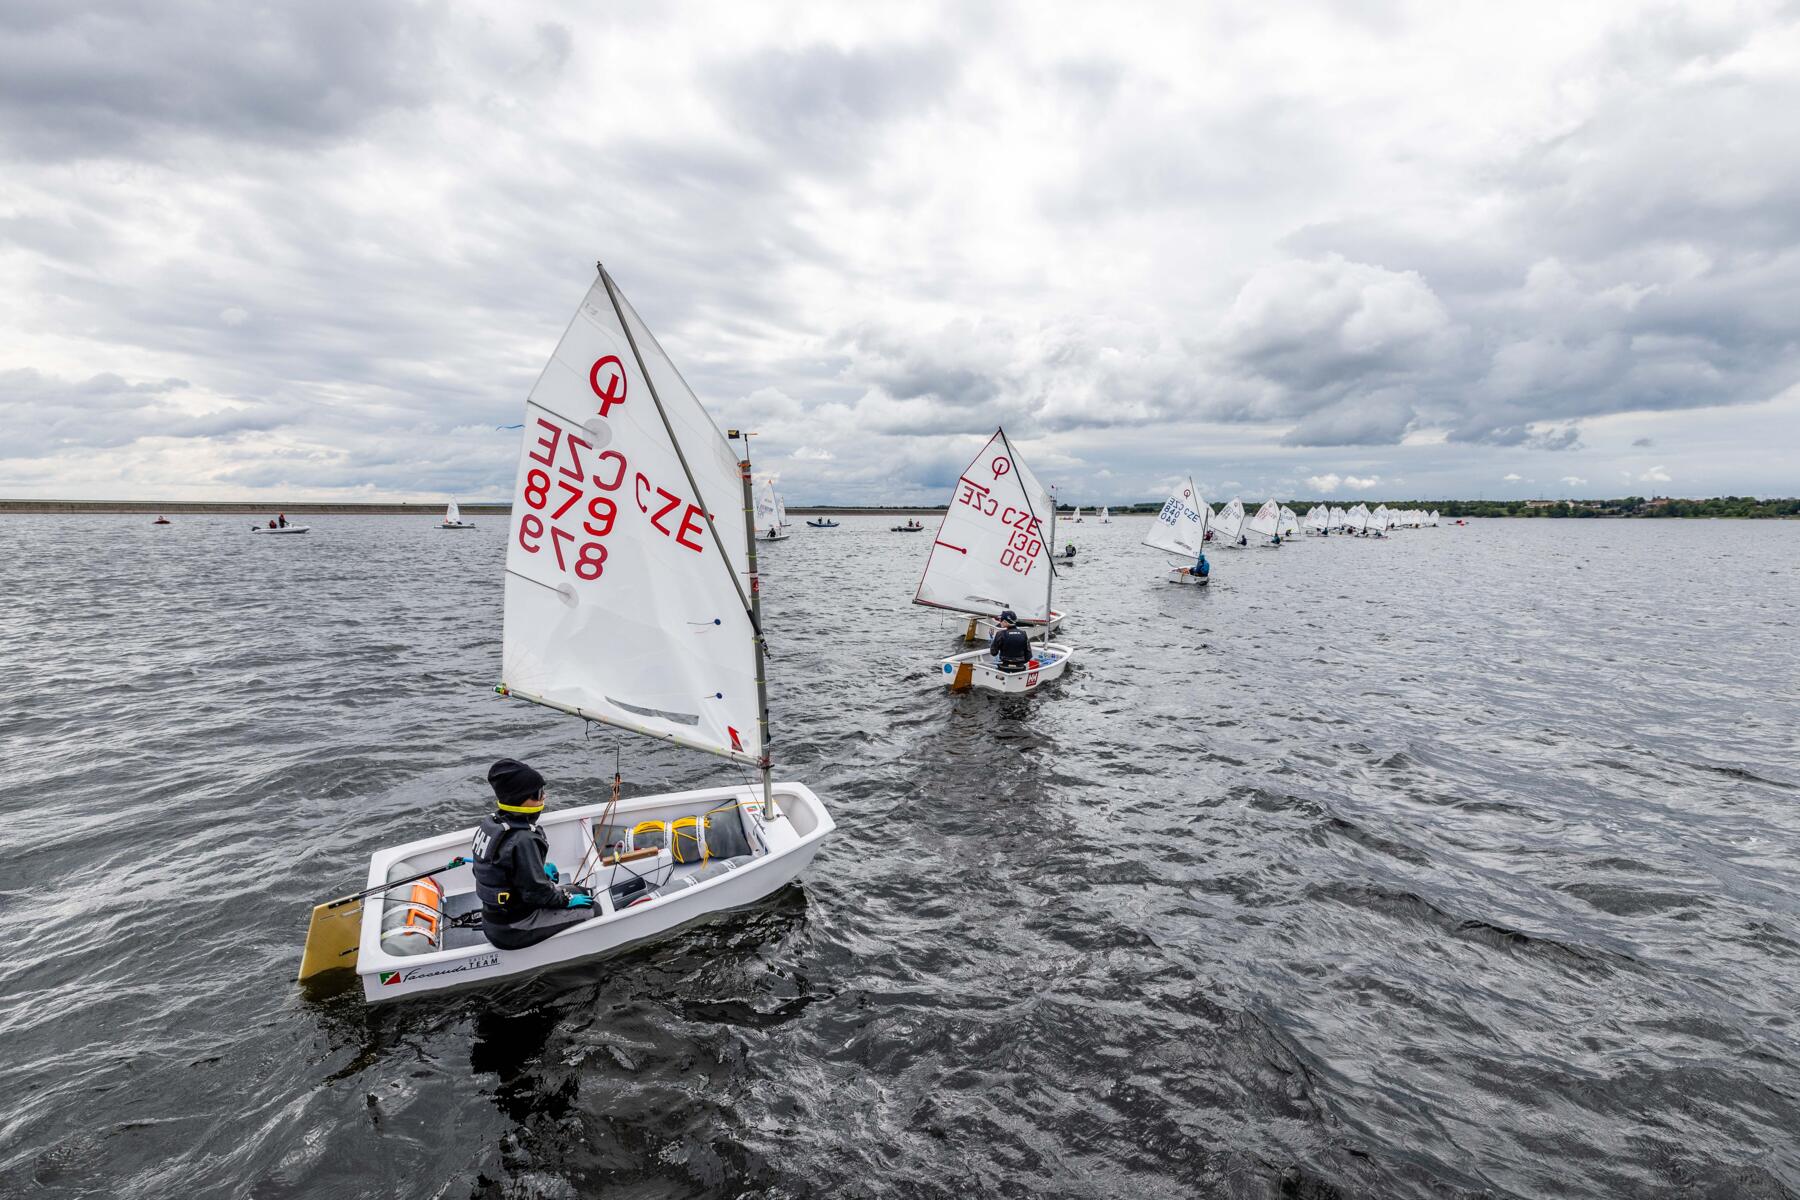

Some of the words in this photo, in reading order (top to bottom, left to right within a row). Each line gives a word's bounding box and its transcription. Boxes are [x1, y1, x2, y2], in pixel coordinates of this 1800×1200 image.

[524, 468, 617, 536] 879
[635, 472, 715, 553] CZE
[1164, 505, 1180, 518] 840
[1184, 508, 1200, 523] CZE
[1001, 507, 1043, 536] CZE
[1008, 530, 1041, 557] 130
[472, 827, 491, 859] HH
[468, 958, 498, 969] TEAM
